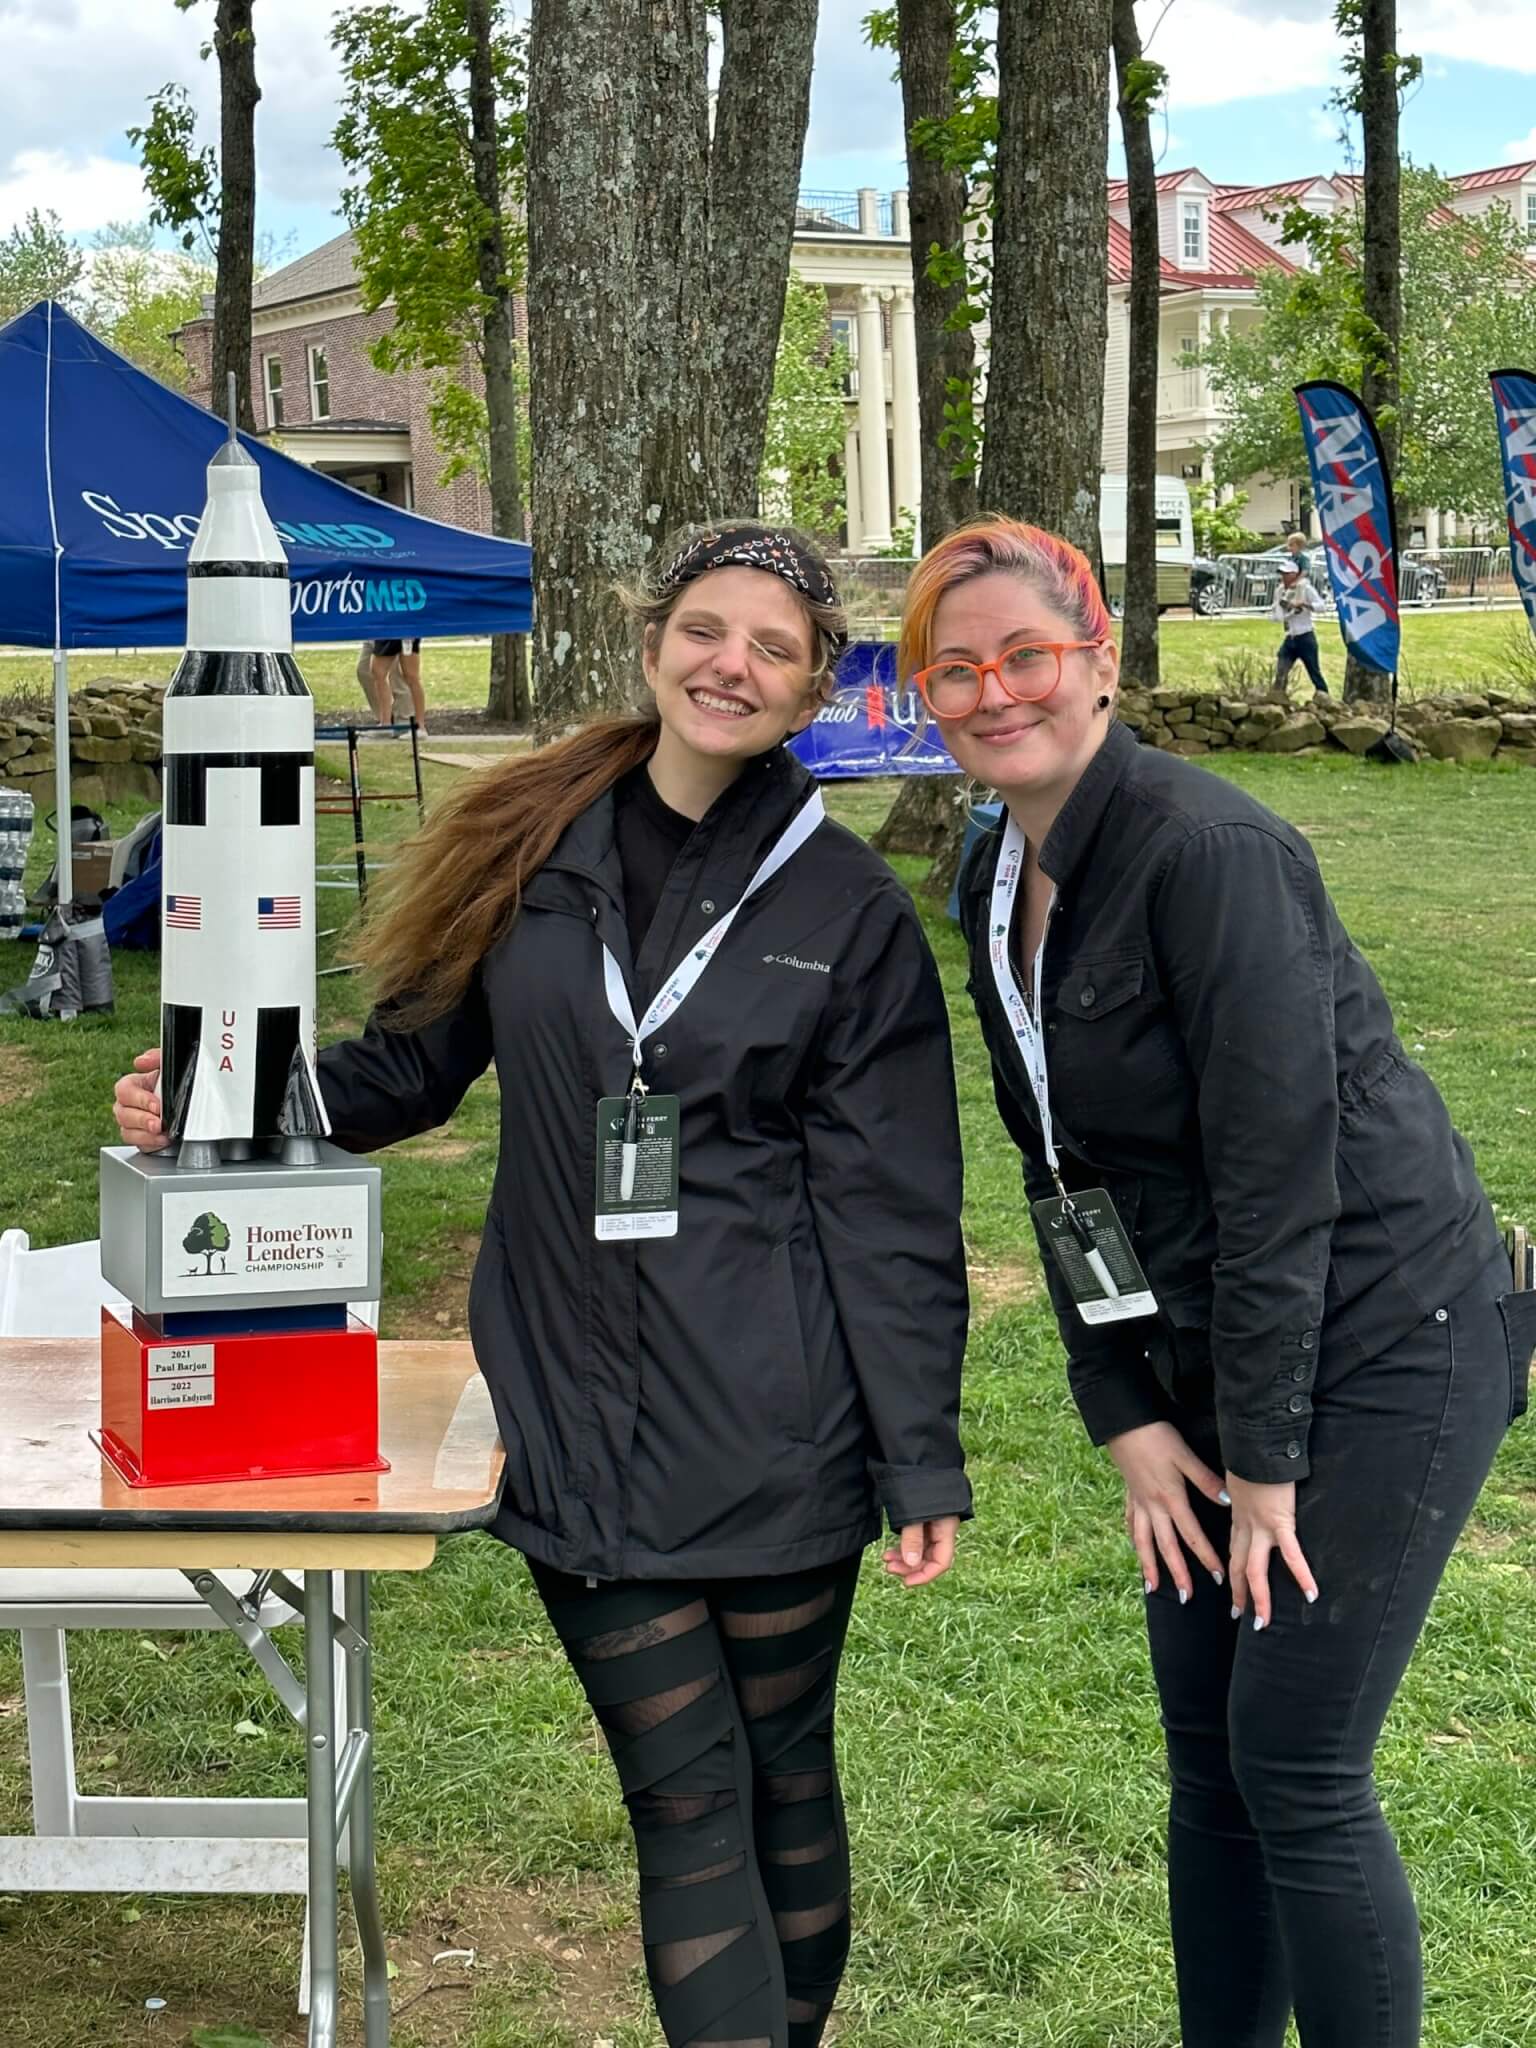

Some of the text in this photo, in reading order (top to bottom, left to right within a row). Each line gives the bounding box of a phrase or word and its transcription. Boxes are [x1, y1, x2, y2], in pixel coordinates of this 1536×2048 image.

[1310, 411, 1387, 642] NASA
[775, 953, 831, 974] Columbia
[218, 1010, 236, 1073] USA
[246, 1224, 353, 1243] HomeTown
[246, 1243, 324, 1262] Lenders
[245, 1262, 324, 1273] CHAMPIONSHIP
[171, 1350, 190, 1359] 2021
[155, 1362, 207, 1373] Paul Barjon
[171, 1382, 191, 1391] 2022
[150, 1396, 181, 1405] Harrison
